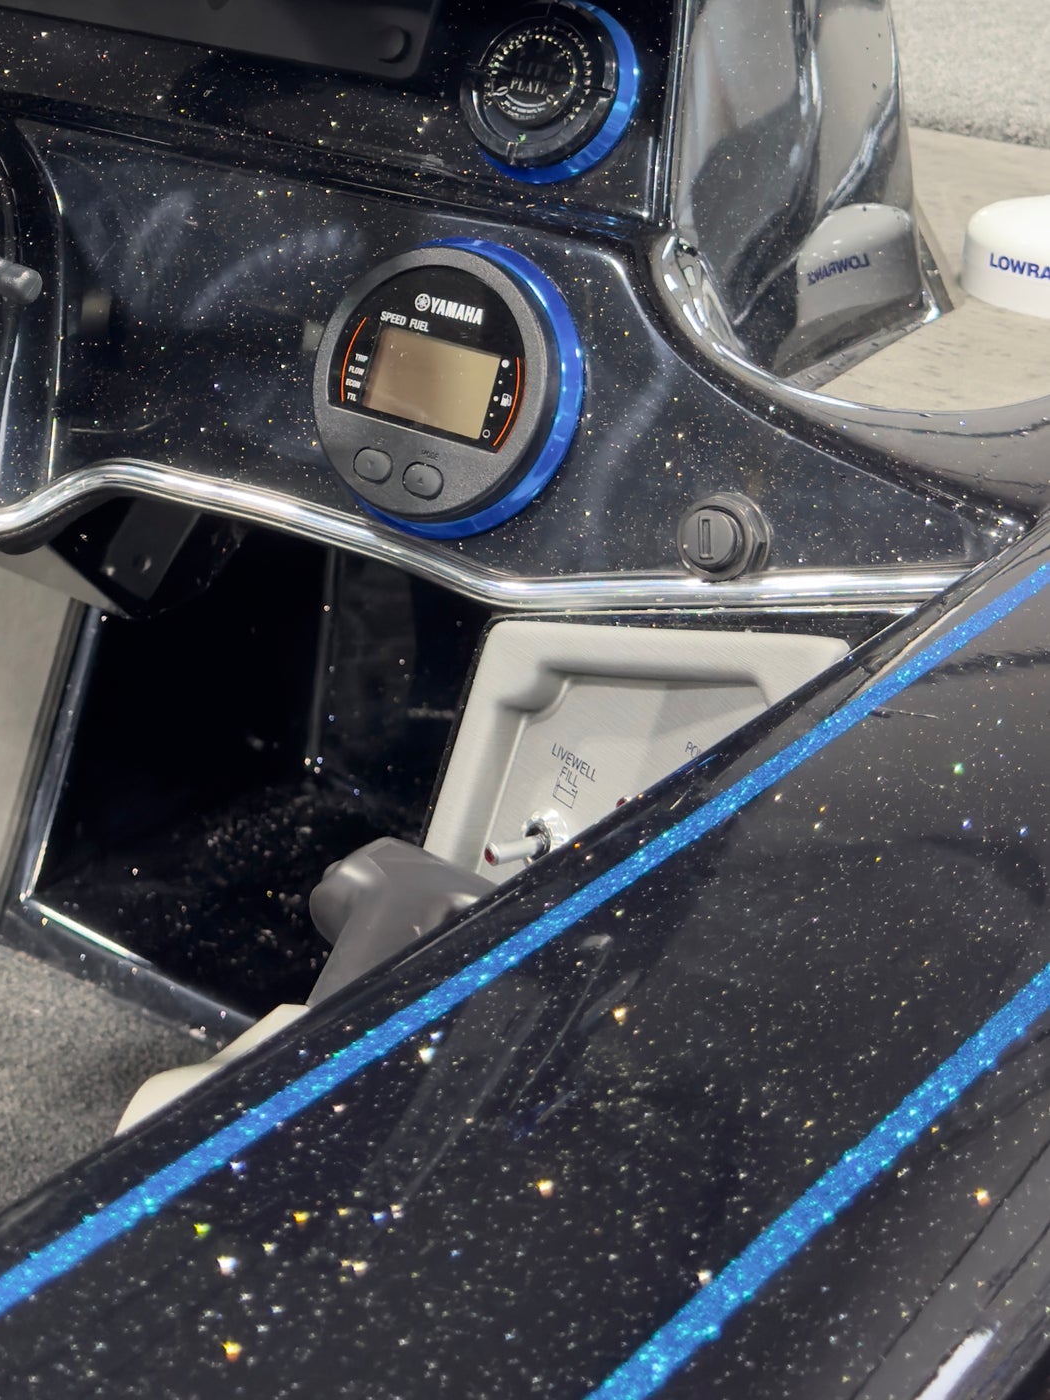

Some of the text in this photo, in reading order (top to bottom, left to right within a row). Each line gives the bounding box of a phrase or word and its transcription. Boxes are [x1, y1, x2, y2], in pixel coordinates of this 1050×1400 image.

[430, 296, 483, 325] YAMAHA
[380, 311, 430, 333] SPEED FUEL
[354, 353, 369, 363] TRIP
[348, 365, 365, 376] FLOW
[345, 378, 361, 388] ECON
[347, 392, 358, 402] TTL
[551, 743, 596, 783] LIVEWELL
[559, 766, 578, 789] FILL
